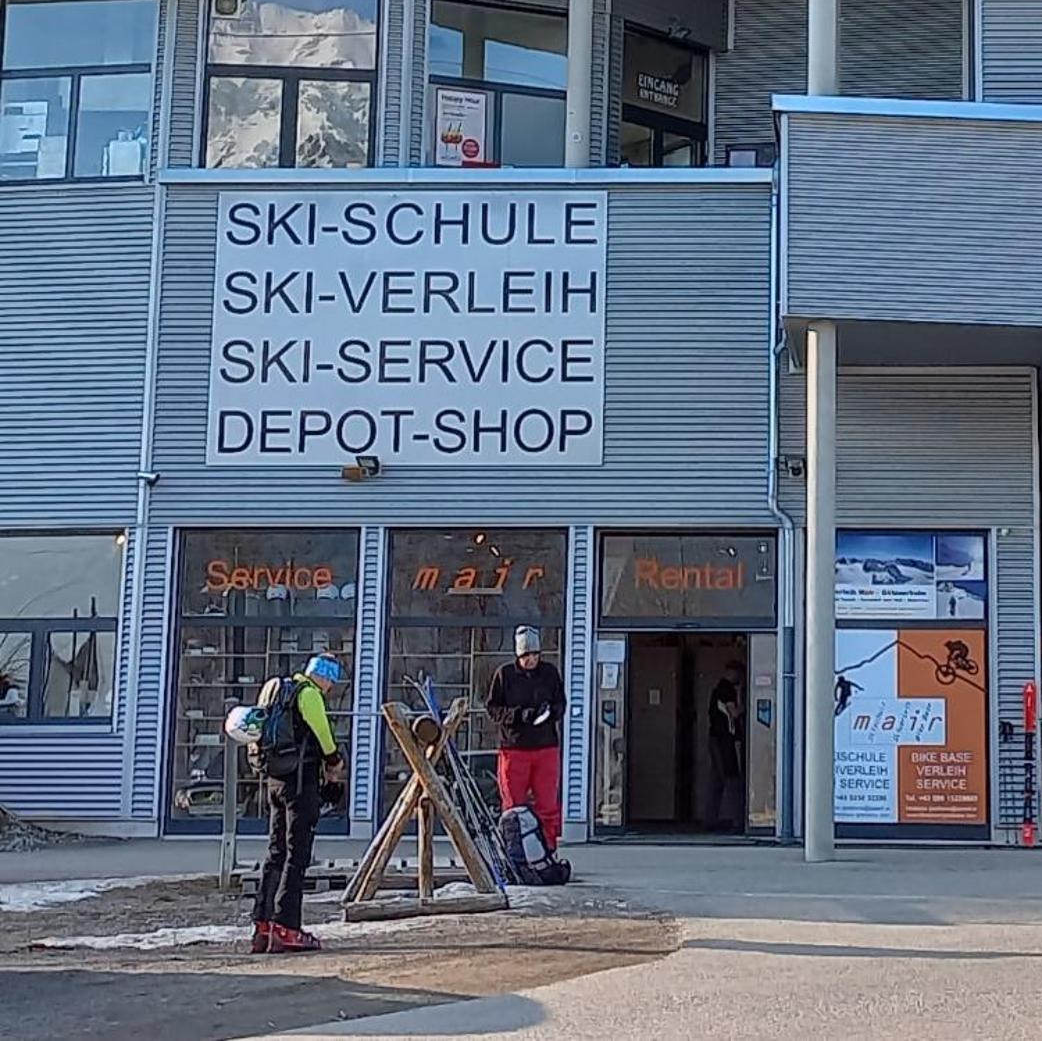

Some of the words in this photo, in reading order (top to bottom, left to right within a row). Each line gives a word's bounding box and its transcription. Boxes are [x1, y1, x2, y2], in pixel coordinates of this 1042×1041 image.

[638, 73, 679, 97] EINGANG
[225, 202, 599, 246] SKI-SCHULE
[222, 270, 598, 315] SKI-VERLEIH
[219, 339, 595, 384] SKI-SERVICE
[217, 408, 594, 454] DEPOT-SHOP
[206, 560, 333, 591] Service
[411, 559, 546, 591] mair
[635, 558, 744, 590] Rental
[853, 709, 943, 732] mair
[911, 752, 938, 763] BIKE
[940, 752, 972, 763] BASE
[916, 765, 967, 777] VERLEIH
[840, 778, 890, 789] SERVICE
[916, 779, 967, 790] SERVICE
